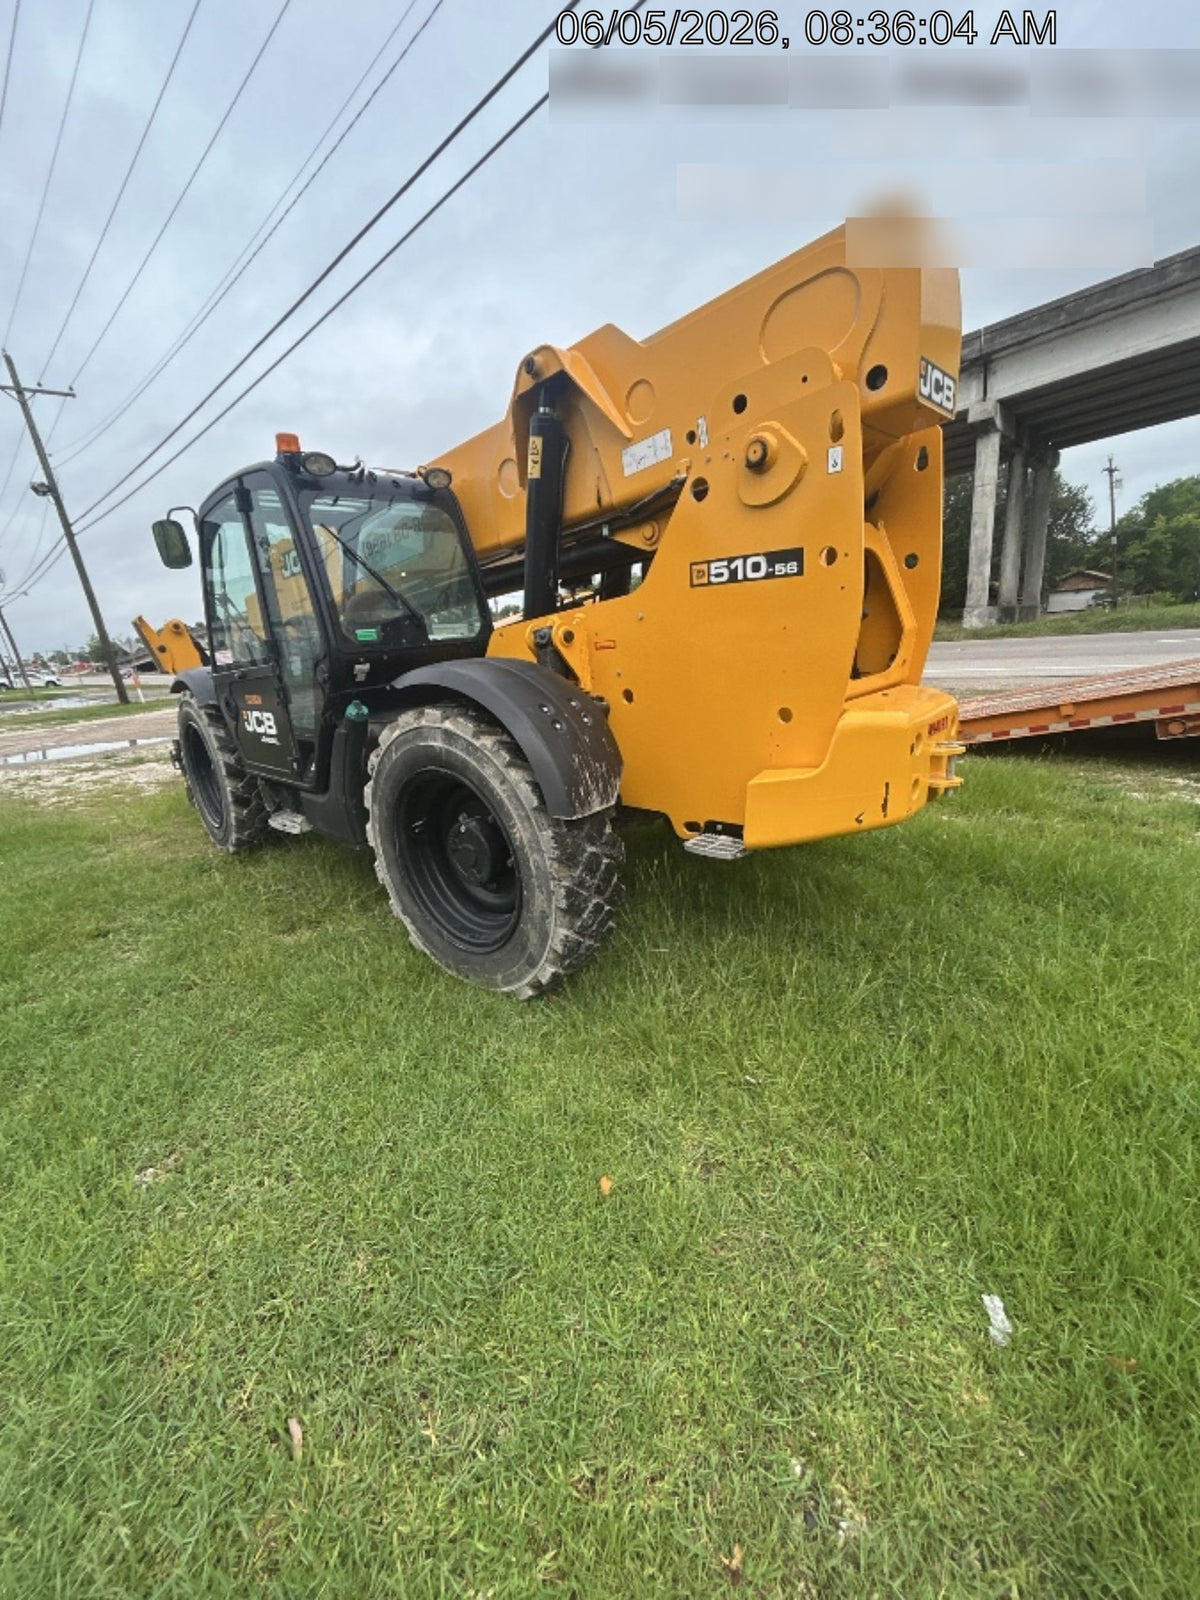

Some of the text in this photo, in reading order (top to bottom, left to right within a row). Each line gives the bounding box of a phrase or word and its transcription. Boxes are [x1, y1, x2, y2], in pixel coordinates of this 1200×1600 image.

[920, 361, 954, 410] JCB
[281, 550, 302, 578] JC
[242, 710, 277, 735] JCB
